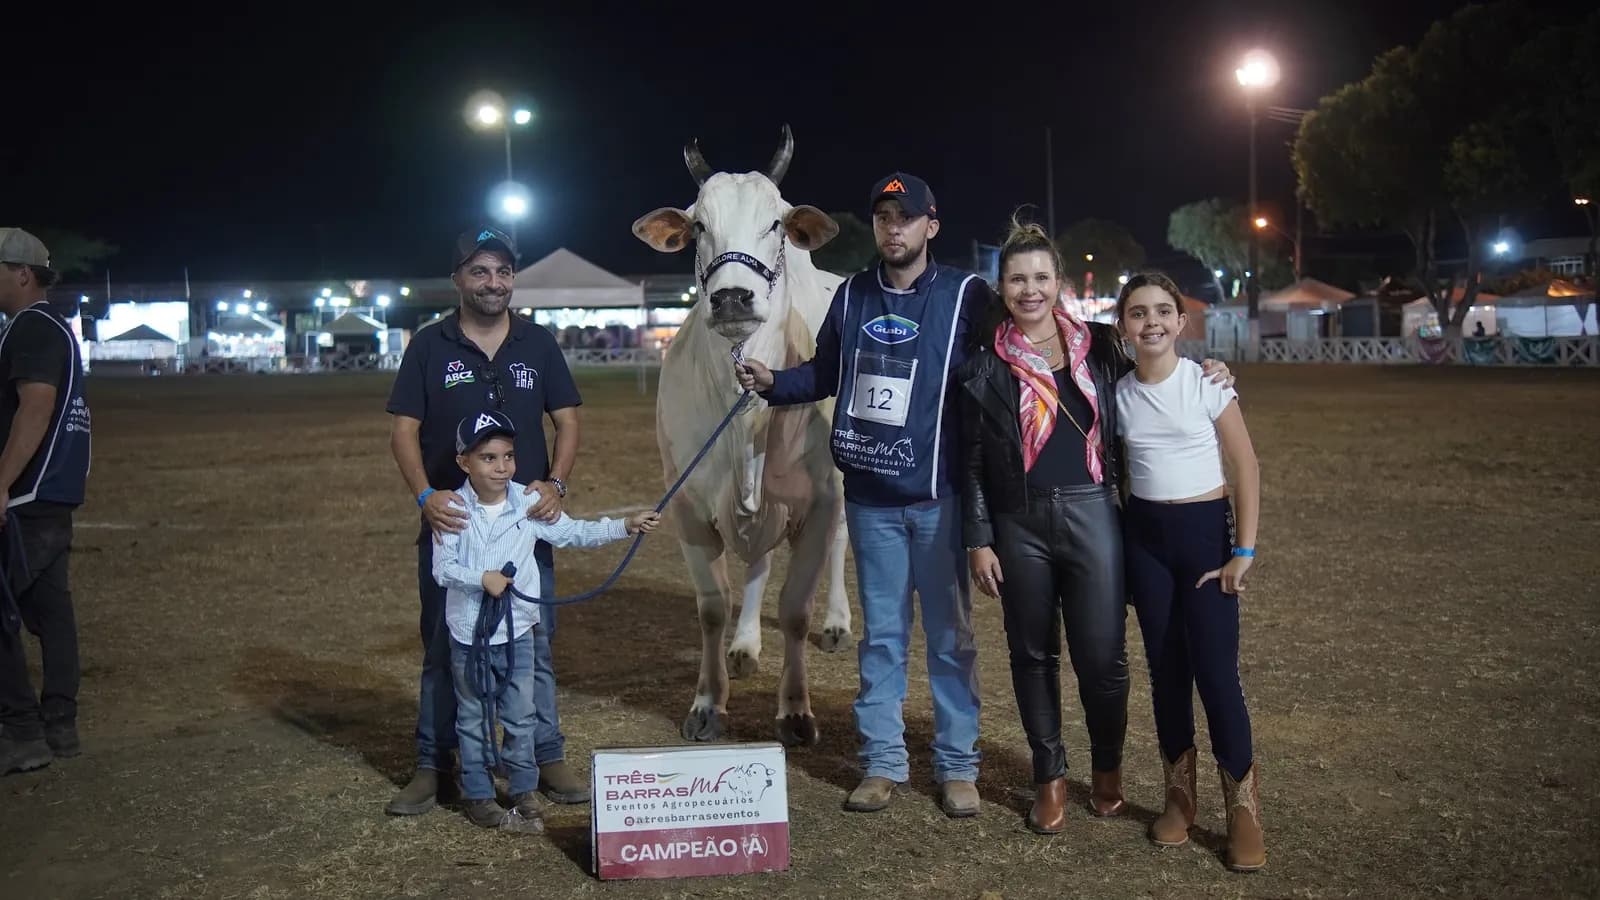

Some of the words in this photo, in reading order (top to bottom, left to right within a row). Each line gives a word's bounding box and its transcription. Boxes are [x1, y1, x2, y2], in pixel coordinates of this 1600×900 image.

[445, 370, 474, 383] ABCZ
[867, 387, 894, 411] 12
[834, 429, 860, 441] TRÊS
[604, 770, 656, 785] TRÊS
[606, 787, 689, 800] BARRAS
[606, 802, 656, 811] Eventos
[662, 797, 754, 810] Agropecuários
[621, 836, 737, 862] CAMPEÃO
